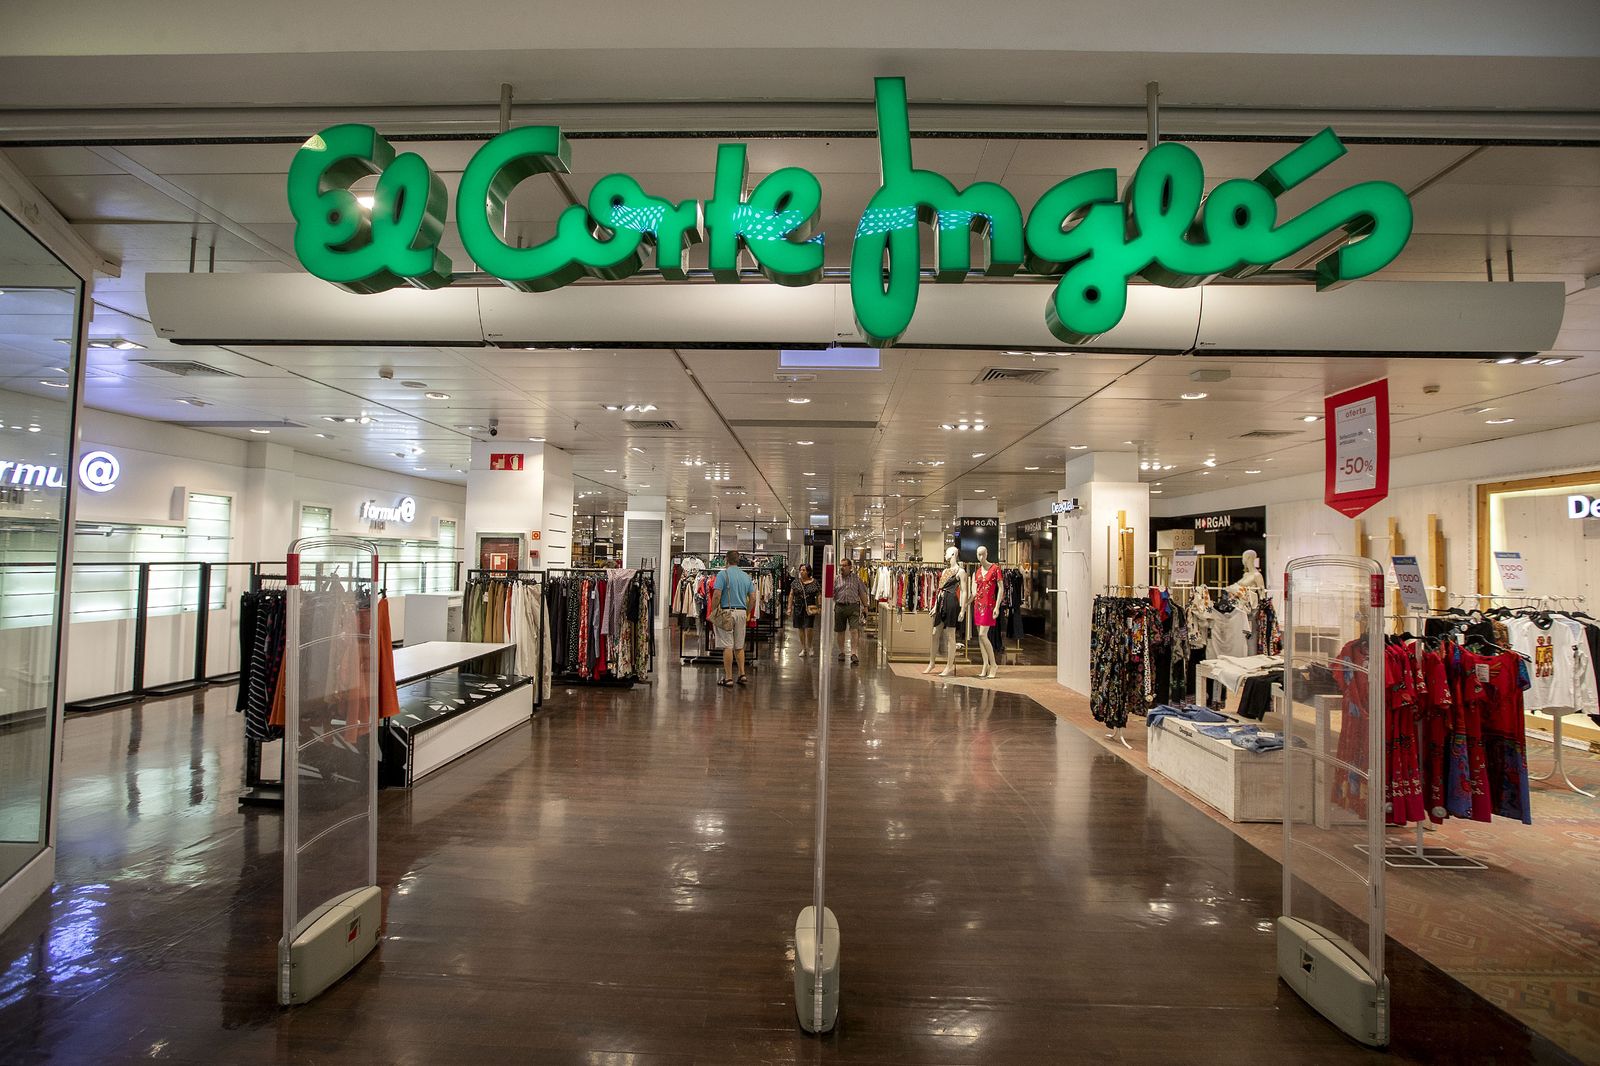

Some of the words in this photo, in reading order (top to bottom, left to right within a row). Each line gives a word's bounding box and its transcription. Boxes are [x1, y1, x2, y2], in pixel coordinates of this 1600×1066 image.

[287, 124, 446, 291] El
[456, 125, 825, 292] Corte
[850, 76, 1414, 347] Inglés
[1345, 407, 1366, 418] oferta
[1340, 456, 1373, 475] -50%
[963, 519, 998, 527] MORGAN
[1194, 515, 1231, 529] MORGAN
[1500, 564, 1524, 572] TODO
[1398, 573, 1421, 583] TODO
